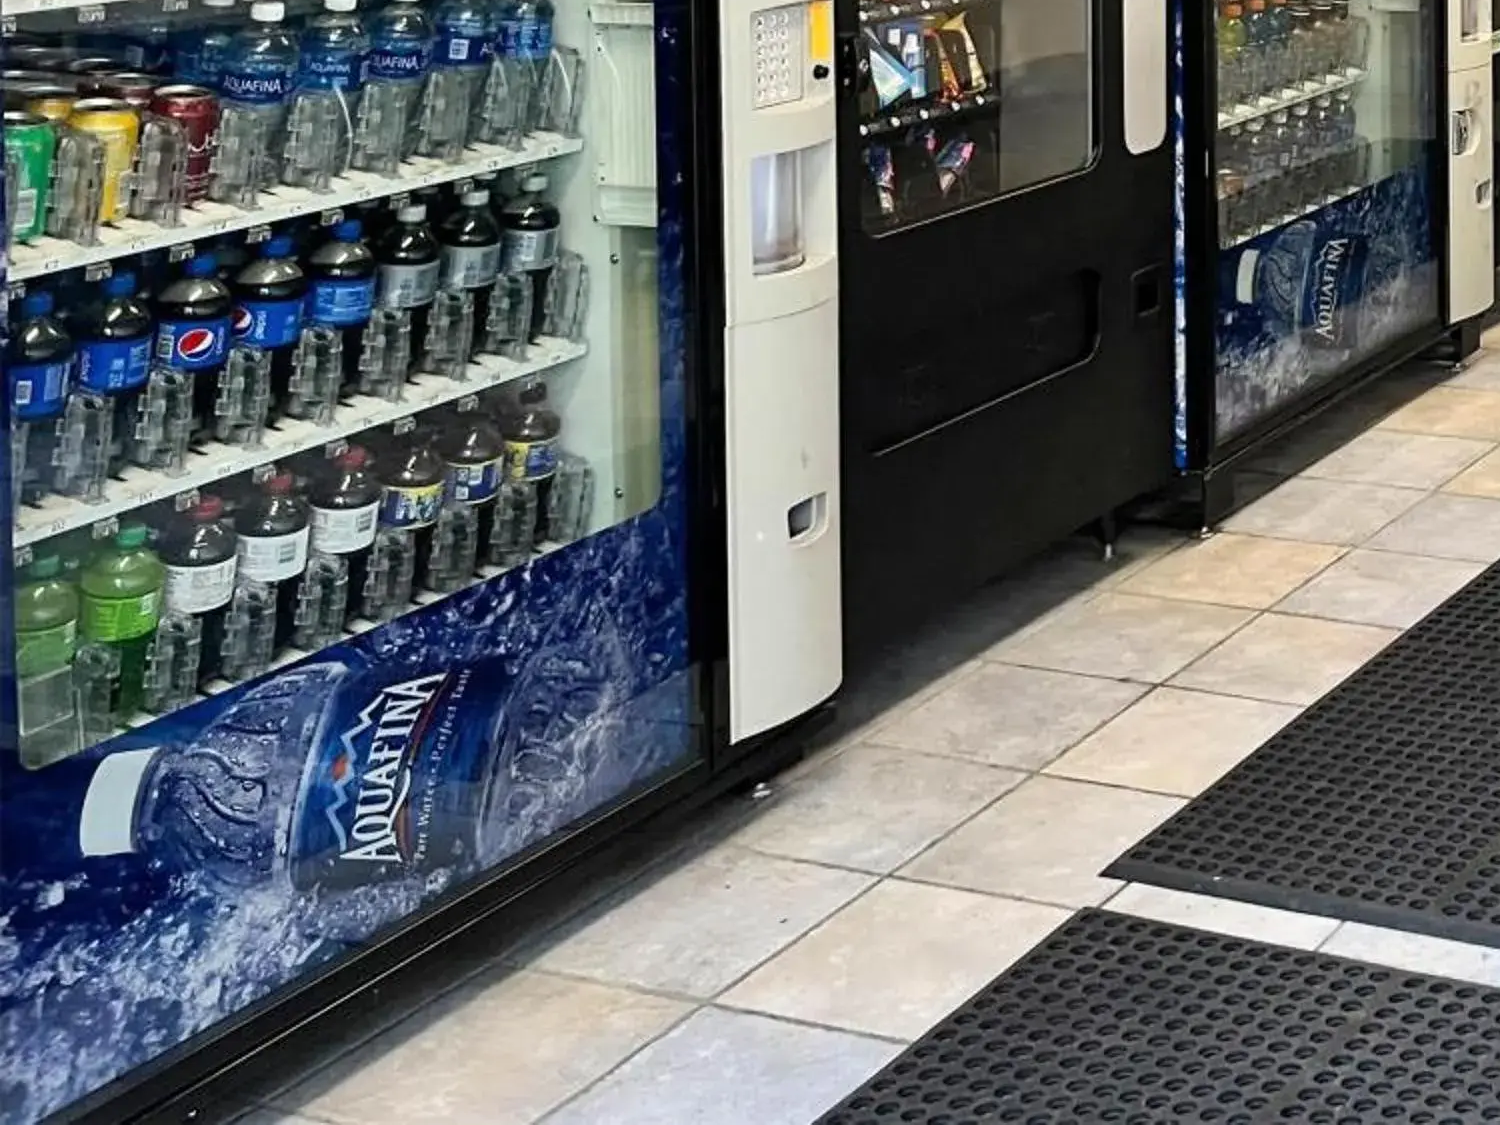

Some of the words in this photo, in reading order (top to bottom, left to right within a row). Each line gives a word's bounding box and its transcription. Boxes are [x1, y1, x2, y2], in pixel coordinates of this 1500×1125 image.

[223, 75, 282, 94] AQUAFINA
[1315, 238, 1348, 341] AQUAFINA
[340, 672, 449, 862] AQUAFINA
[418, 780, 438, 826] Water
[431, 705, 457, 761] Perfect
